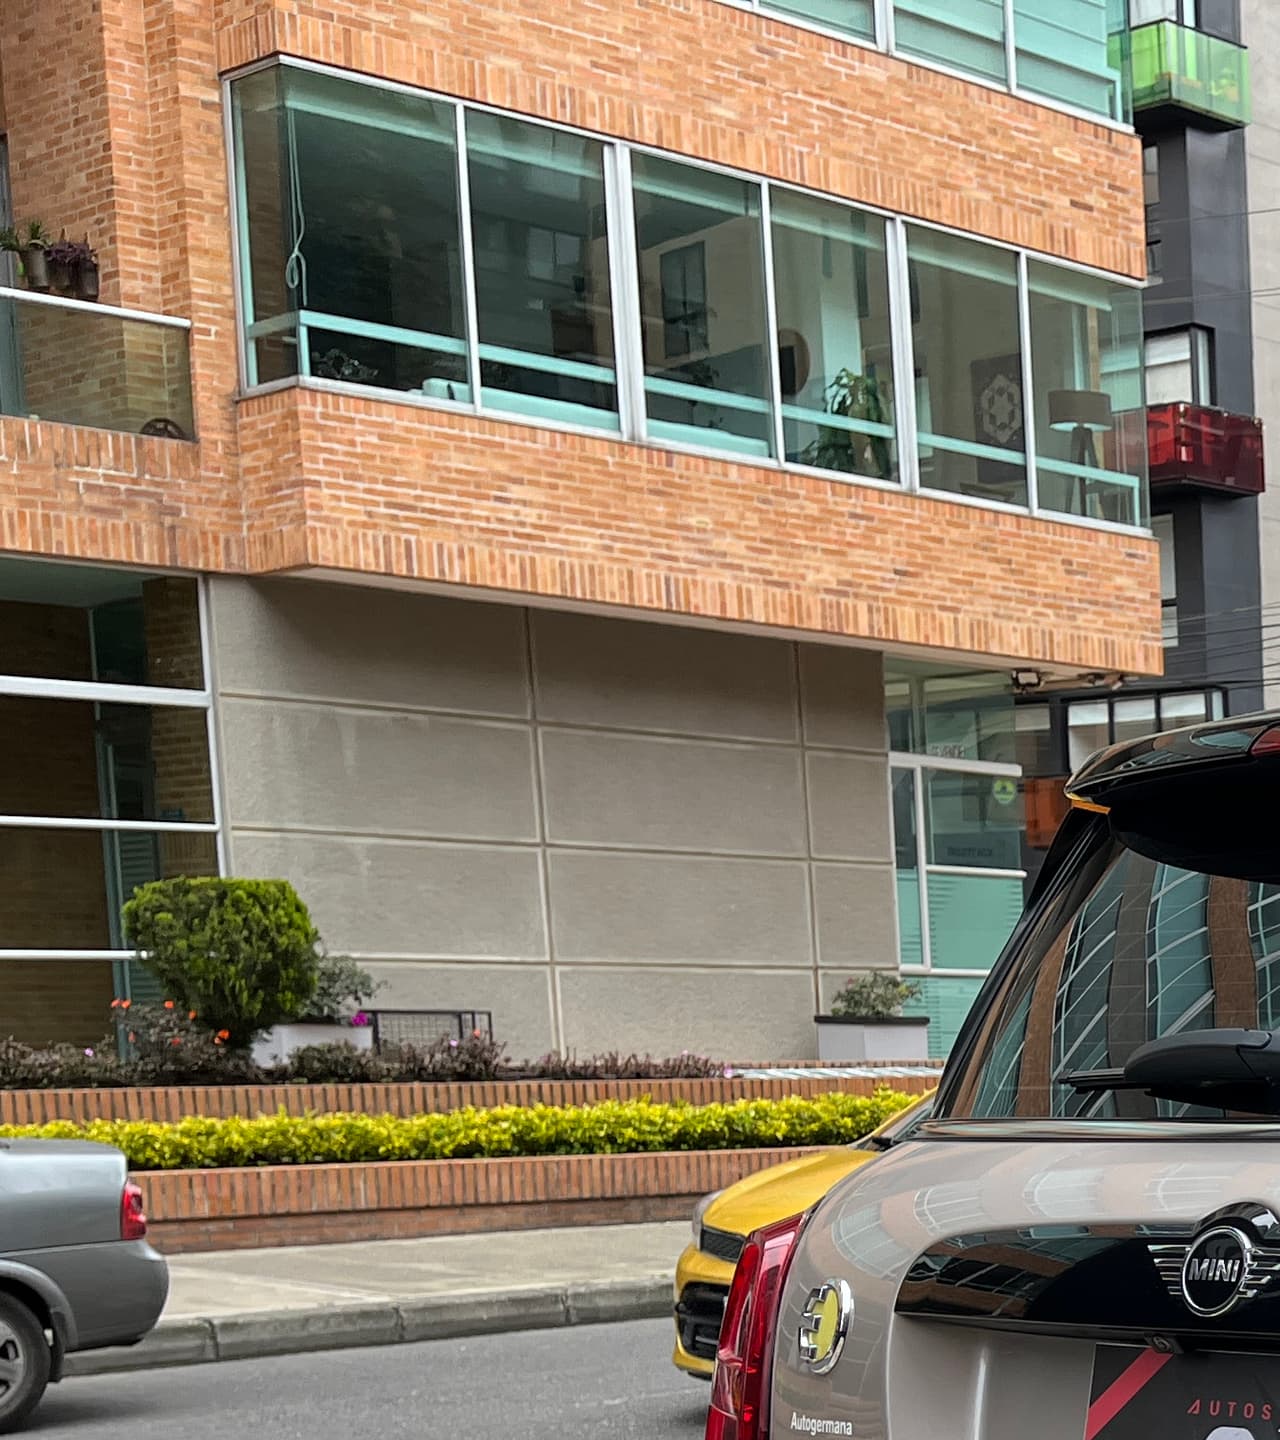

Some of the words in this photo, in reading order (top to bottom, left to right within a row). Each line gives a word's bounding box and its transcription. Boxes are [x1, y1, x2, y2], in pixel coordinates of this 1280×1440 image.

[1188, 1258, 1240, 1283] MINI
[1187, 1399, 1273, 1420] AUTOS
[790, 1411, 853, 1436] Autogermana
